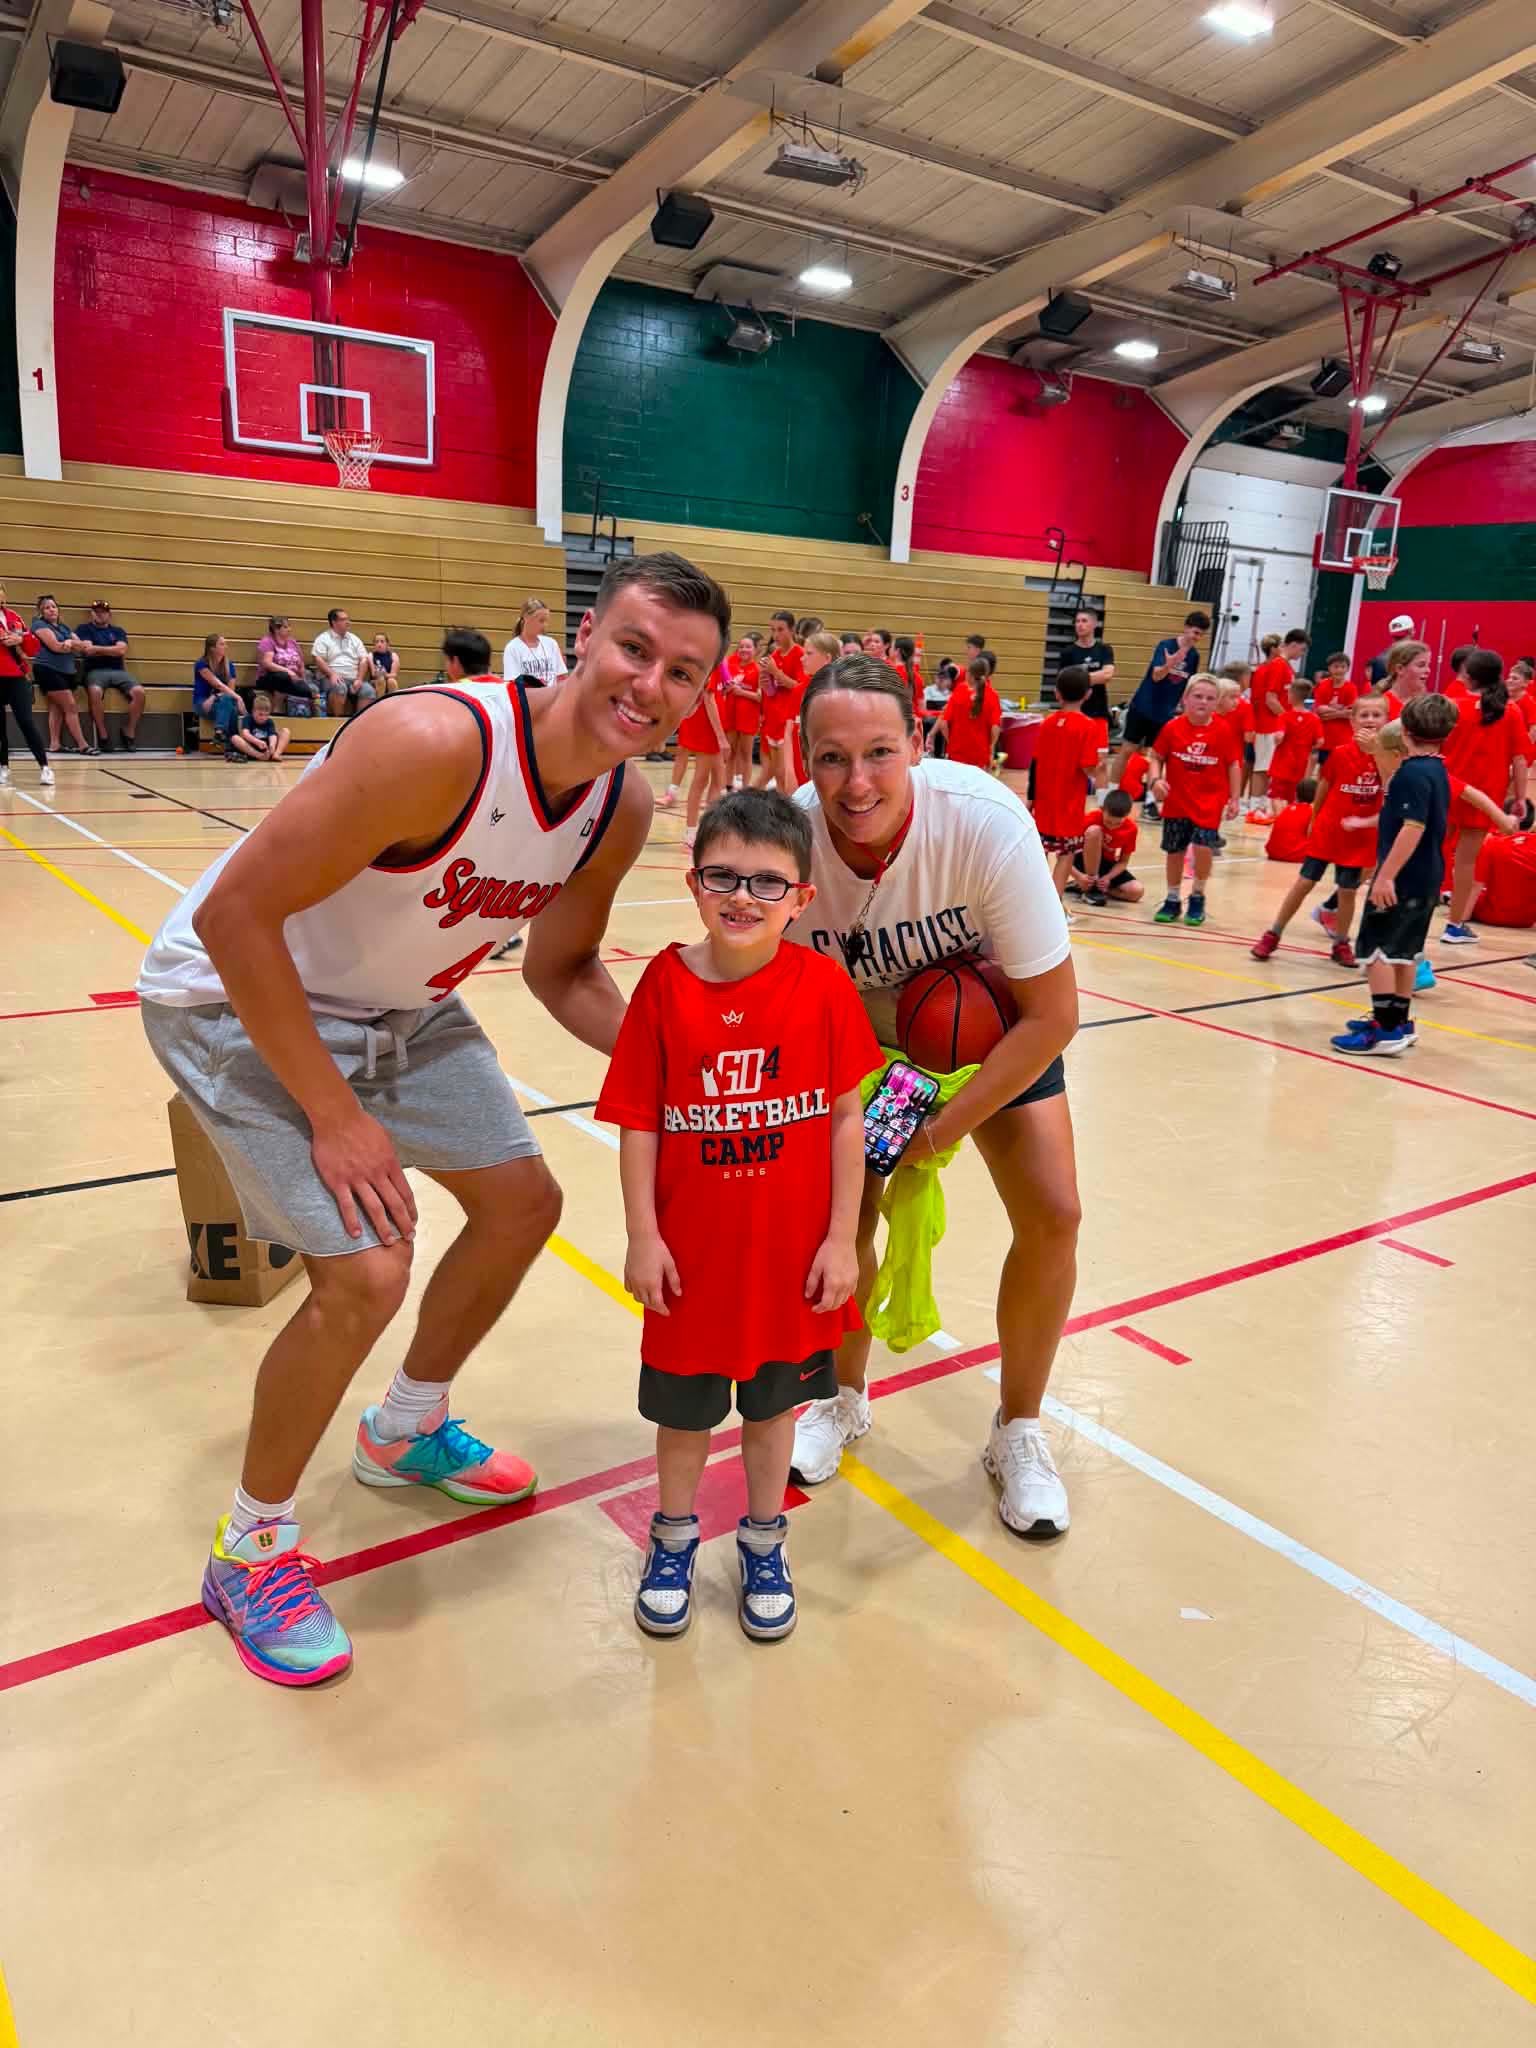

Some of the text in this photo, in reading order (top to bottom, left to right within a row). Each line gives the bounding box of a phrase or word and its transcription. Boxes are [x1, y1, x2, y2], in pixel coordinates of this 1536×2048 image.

[32, 367, 44, 391] 1
[901, 485, 910, 501] 3
[424, 941, 497, 1003] 4
[664, 1088, 830, 1132] BASKETBALL
[701, 1132, 784, 1166] CAMP
